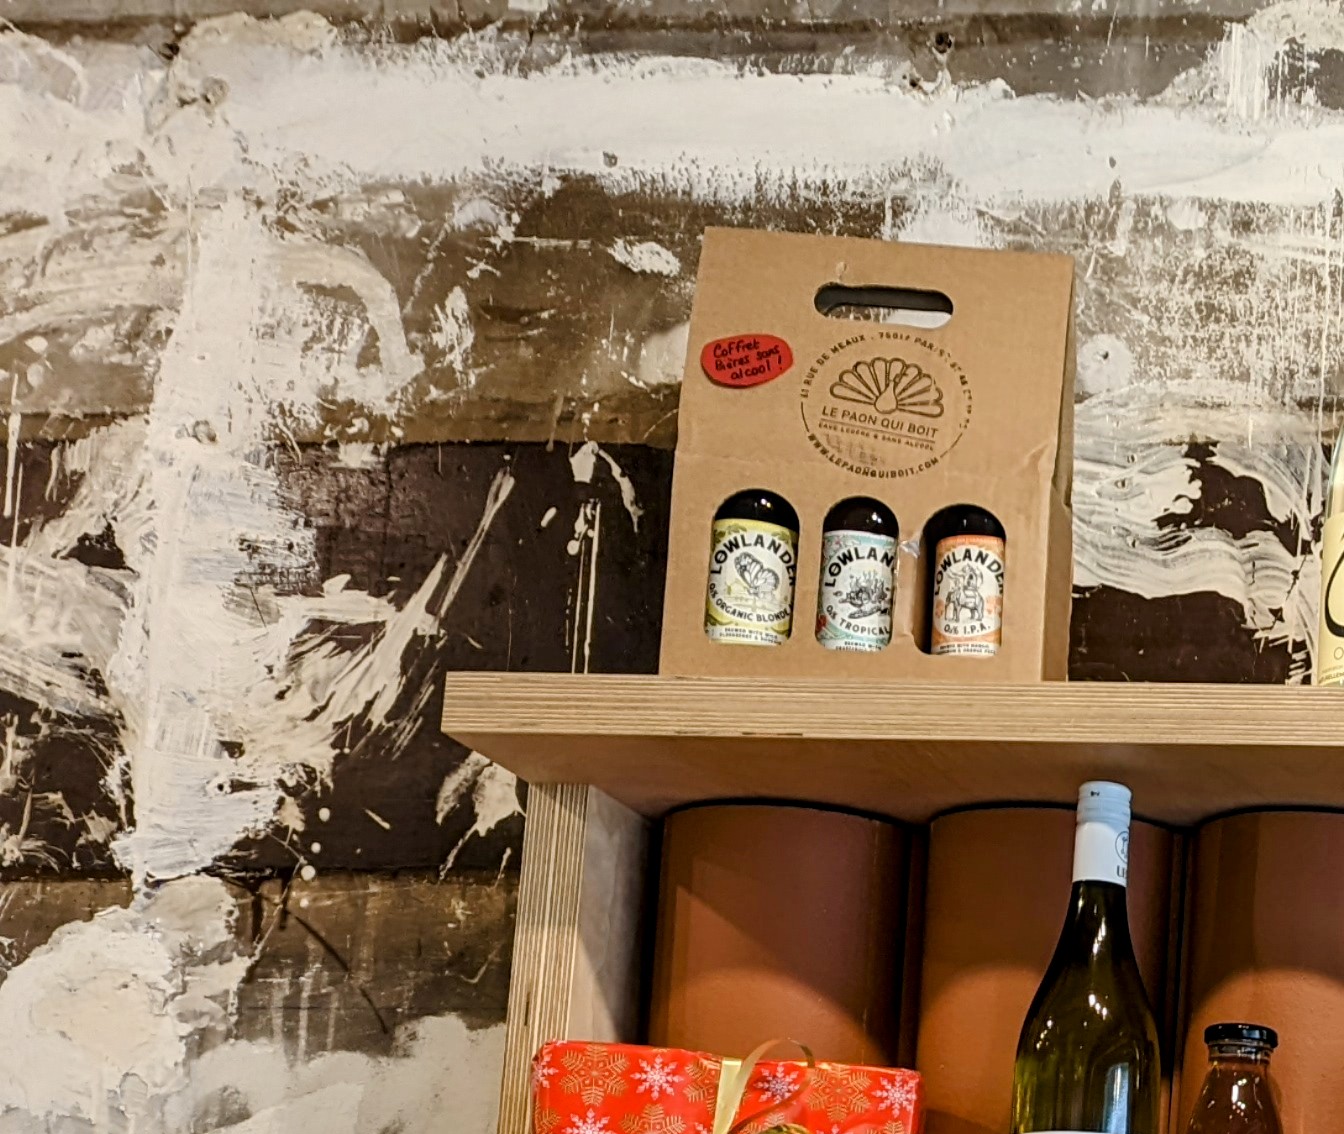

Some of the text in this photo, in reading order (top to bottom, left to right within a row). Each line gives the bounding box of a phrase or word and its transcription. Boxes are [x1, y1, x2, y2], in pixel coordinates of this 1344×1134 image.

[713, 338, 760, 359] Coffret
[757, 345, 781, 360] sans
[803, 365, 819, 387] RUE
[816, 351, 831, 366] DE
[830, 334, 866, 355] MEAUX
[731, 362, 772, 381] alcool
[822, 405, 939, 439] LE PAON QUI BOIT
[715, 597, 753, 622] ORGANIC
[839, 616, 892, 637] TROPICAL
